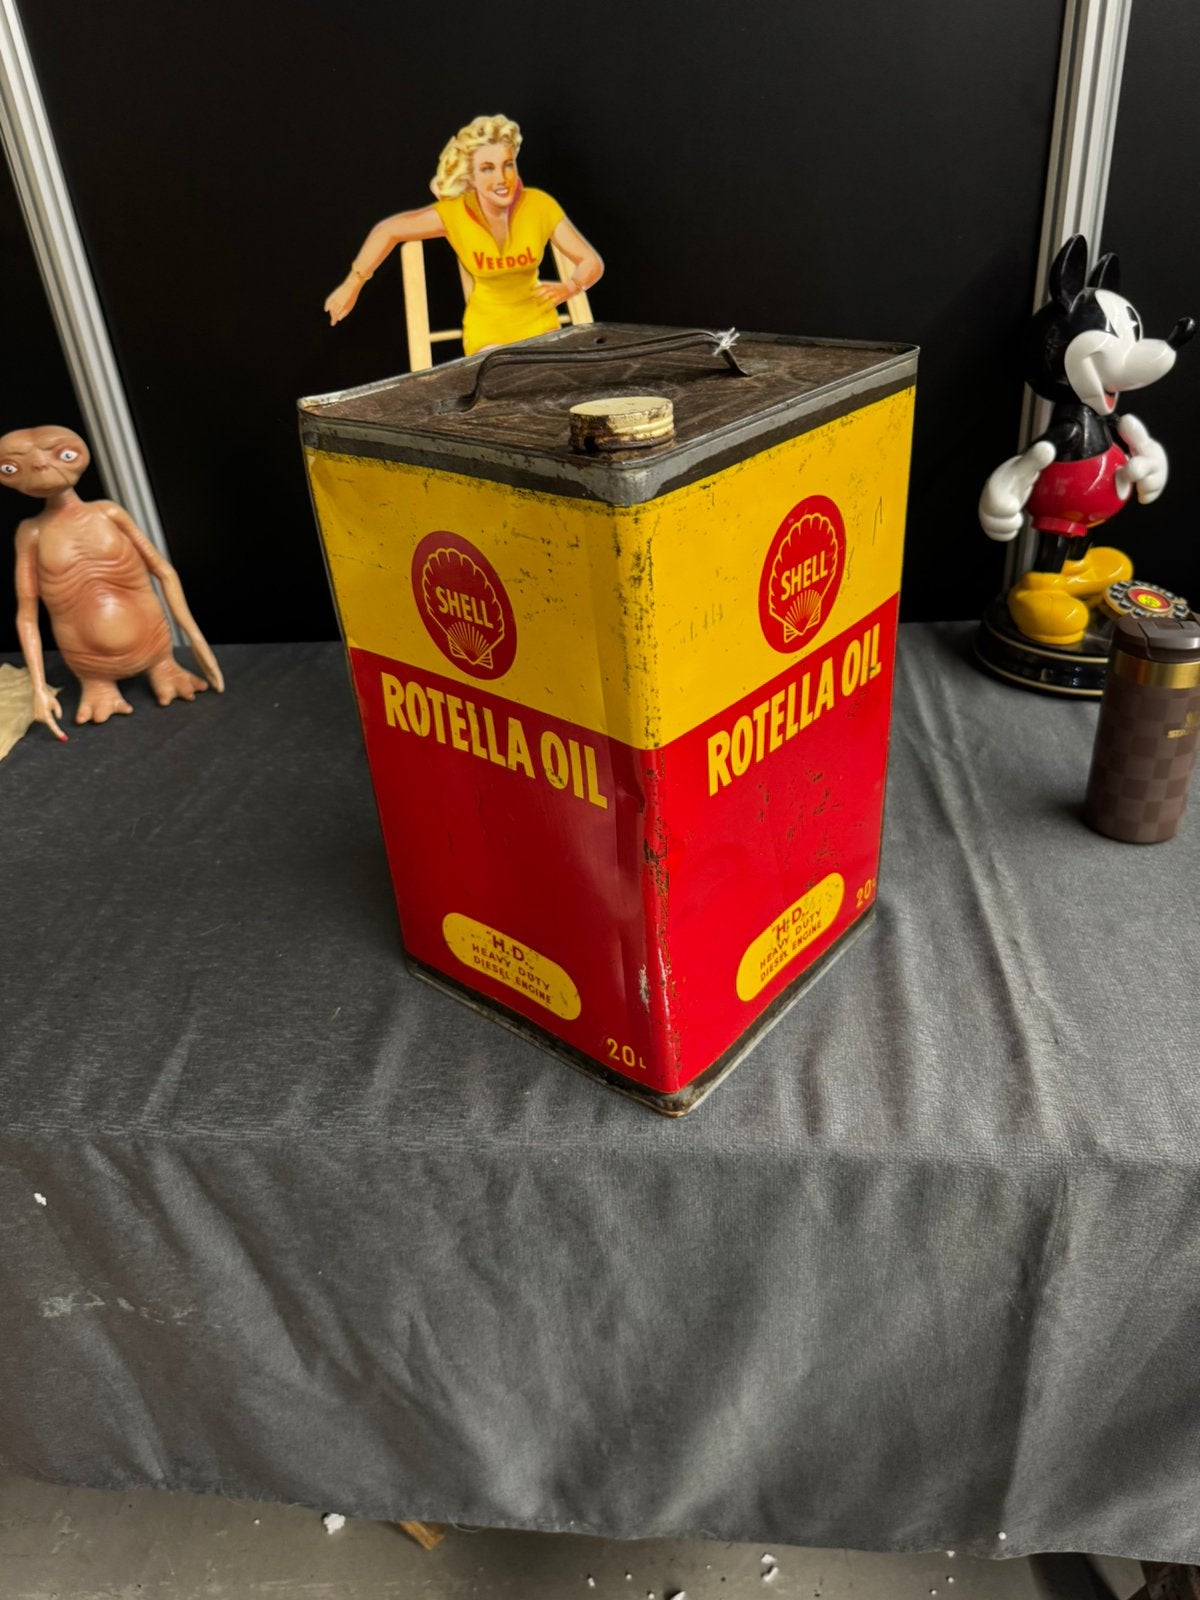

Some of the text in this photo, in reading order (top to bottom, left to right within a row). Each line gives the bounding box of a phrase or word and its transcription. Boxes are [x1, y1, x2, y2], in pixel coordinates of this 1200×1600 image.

[472, 246, 537, 270] VEEDOL
[780, 549, 829, 602] SHELL
[434, 585, 495, 629] SHELL
[707, 622, 883, 798] ROTELLA OIL
[380, 670, 608, 810] ROTELLA OIL
[759, 907, 821, 970] HEAVY DUTY
[760, 920, 822, 982] DIESEL ENGINE
[472, 943, 550, 991] HEAVY DUTY
[473, 955, 552, 1004] DIESEL ENGINE
